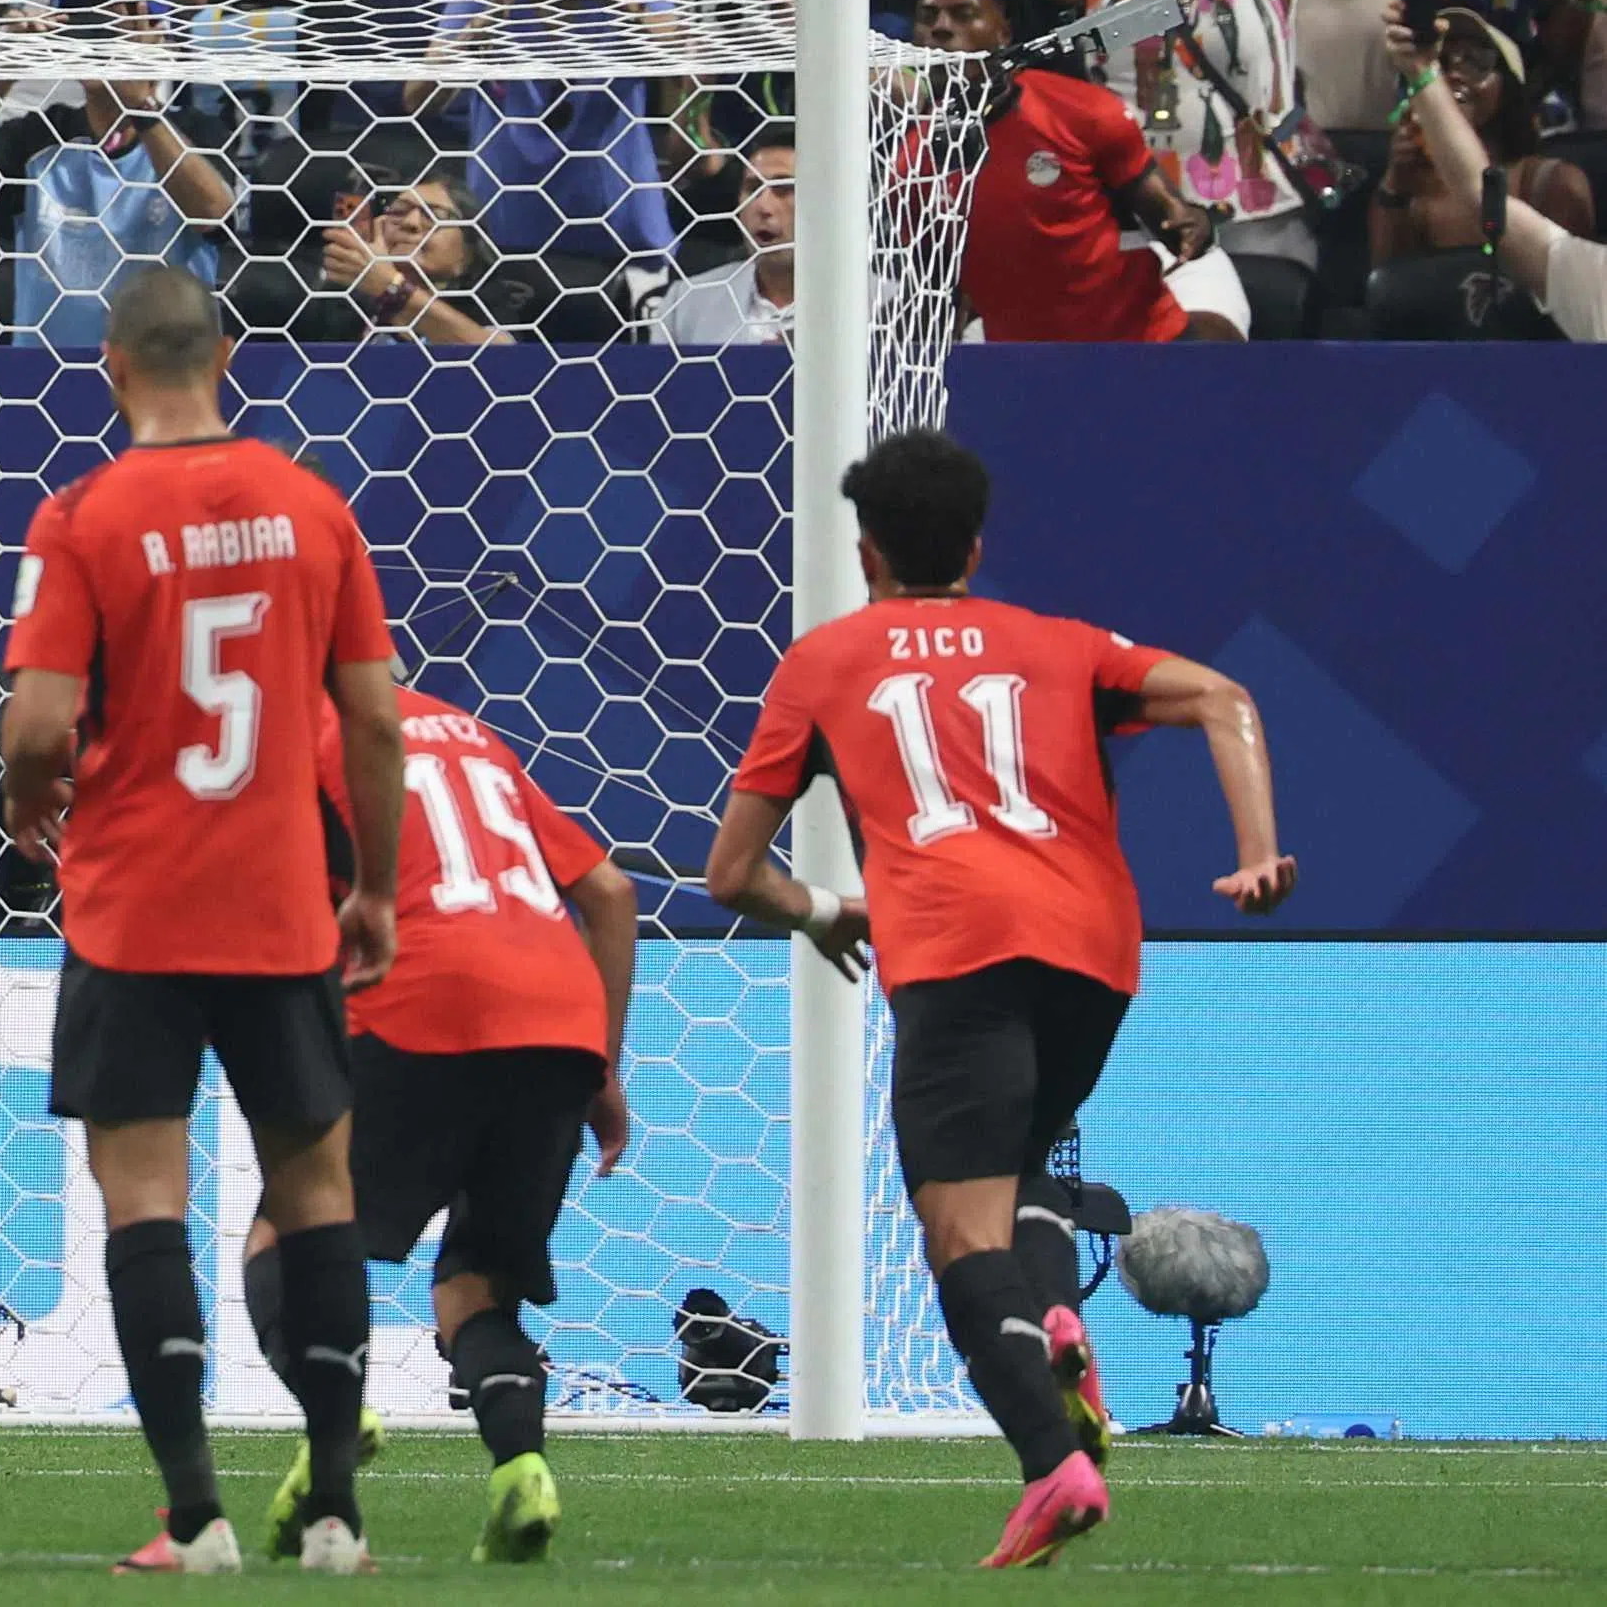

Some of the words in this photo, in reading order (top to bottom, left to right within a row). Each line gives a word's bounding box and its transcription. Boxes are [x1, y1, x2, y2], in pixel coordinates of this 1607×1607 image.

[174, 591, 273, 802] 5
[887, 627, 985, 660] ZICO
[403, 752, 568, 922] 15
[866, 672, 1058, 848] 11
